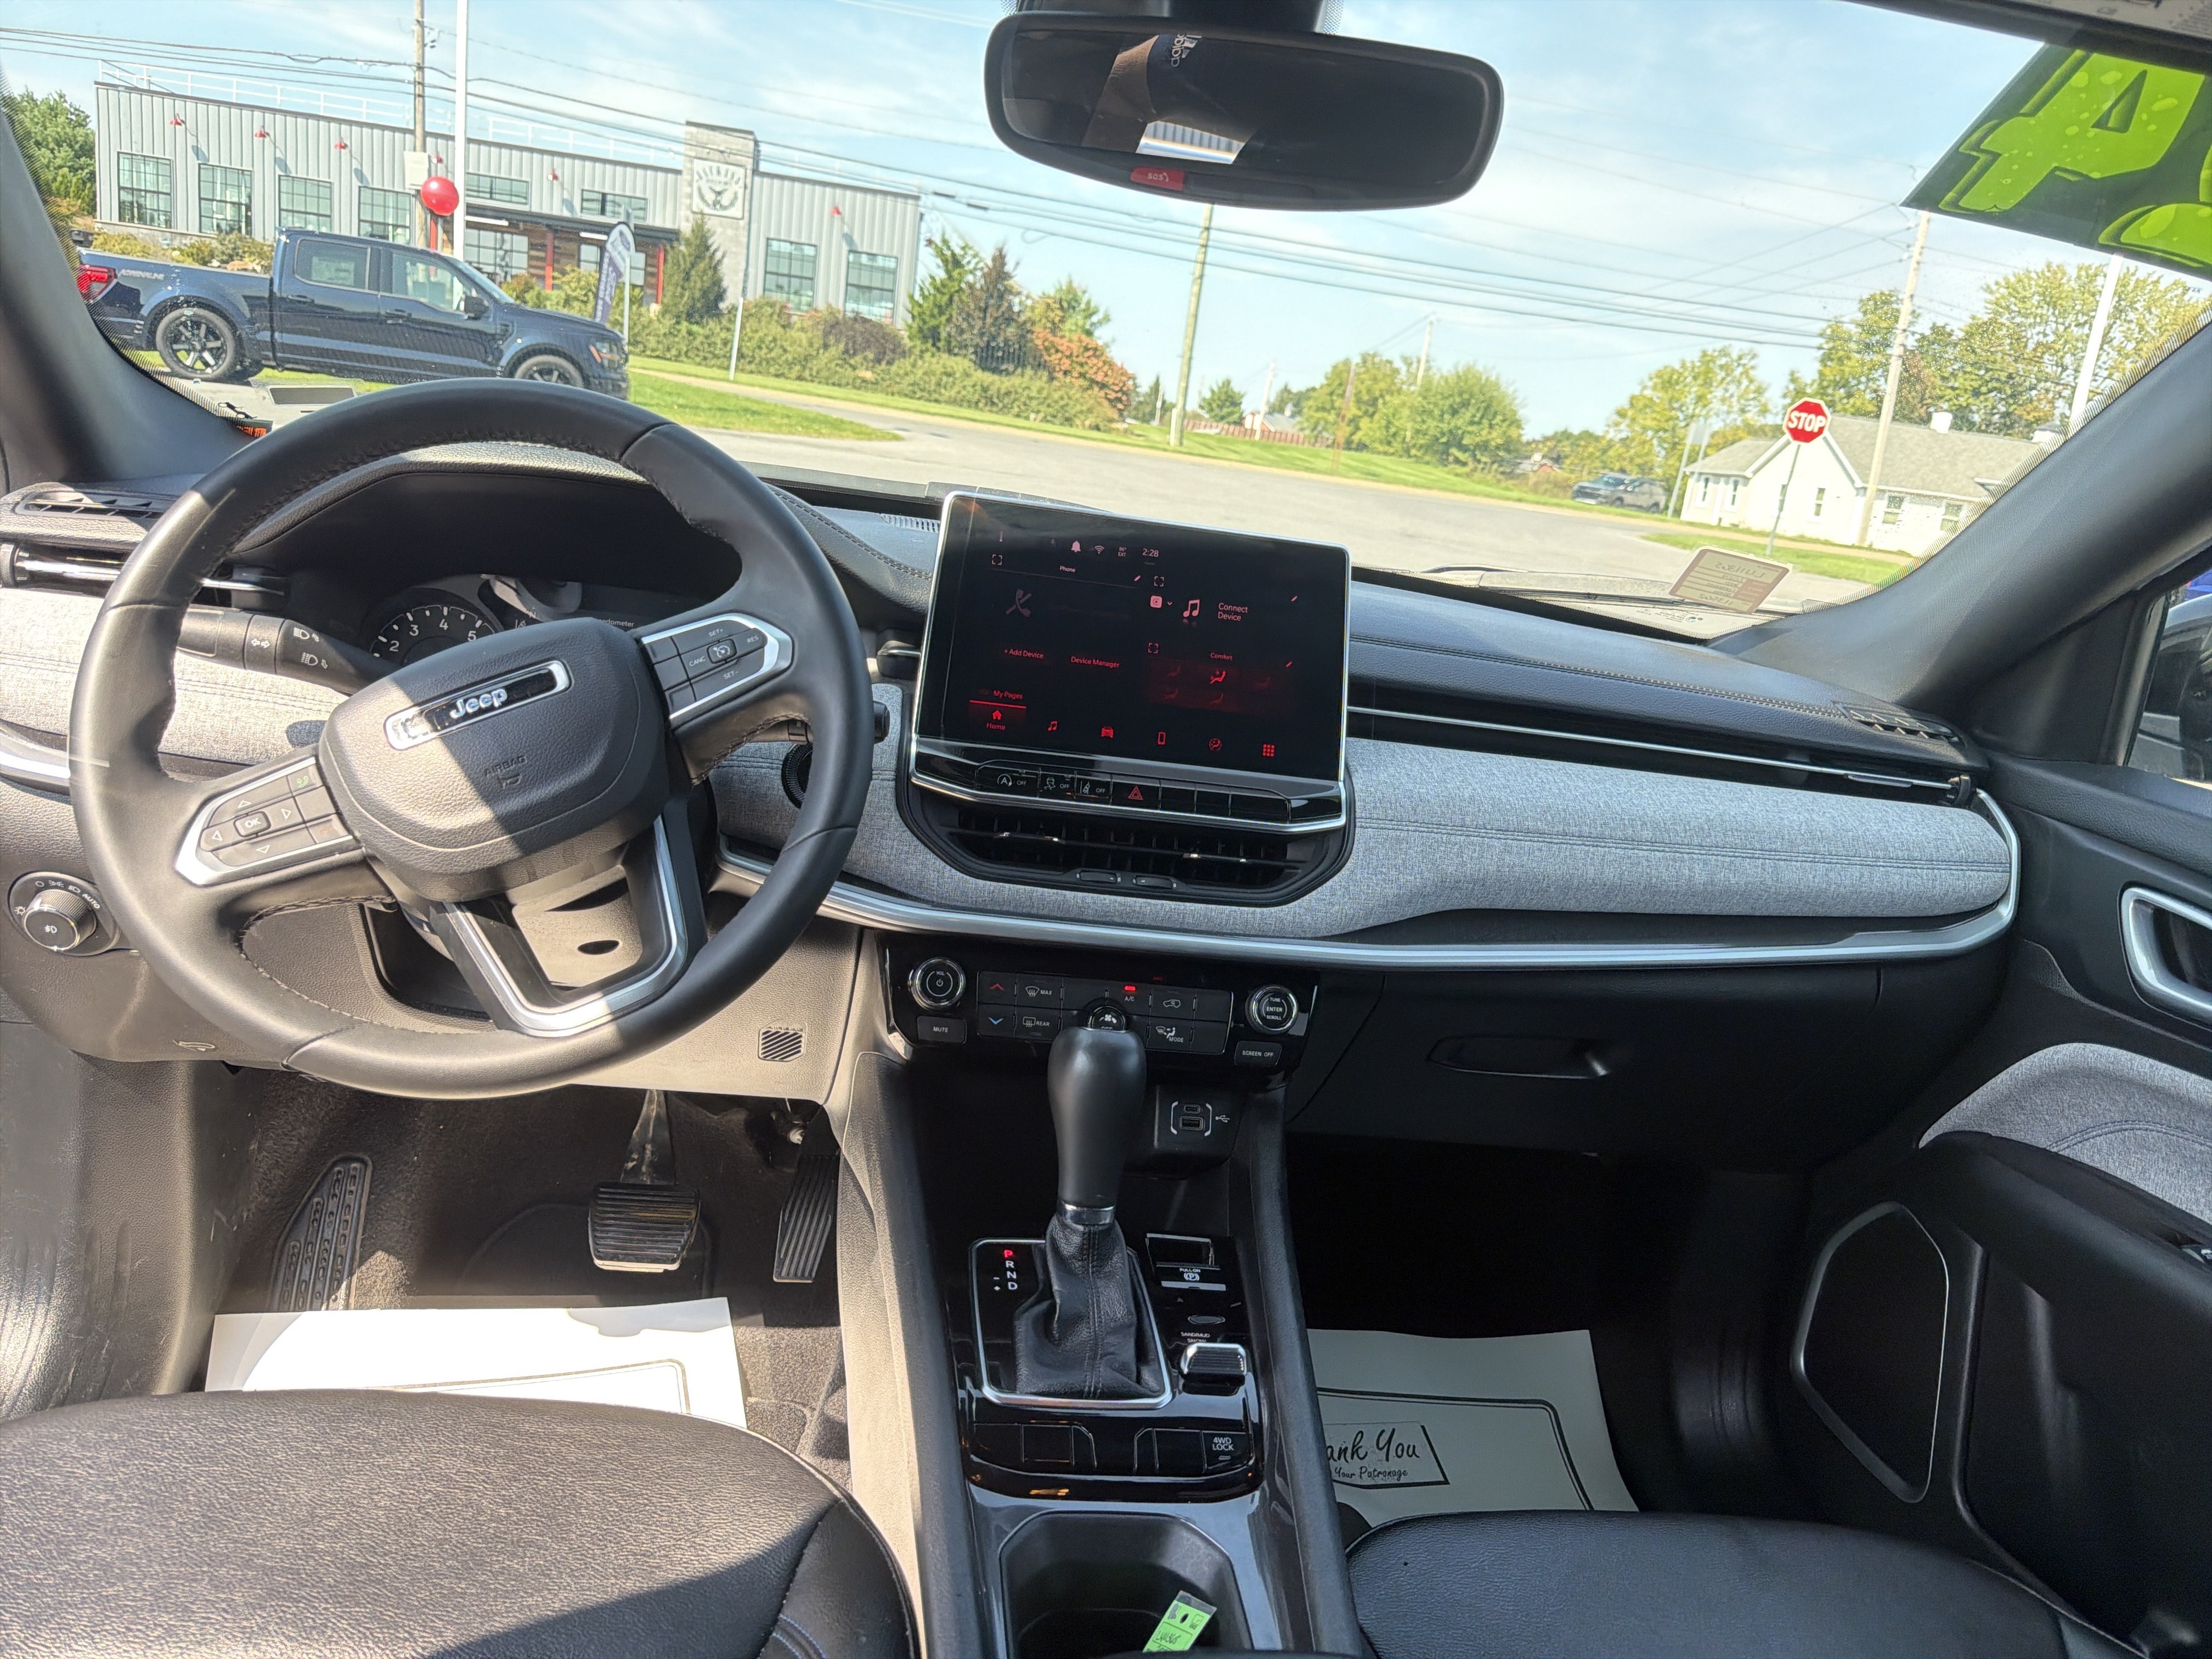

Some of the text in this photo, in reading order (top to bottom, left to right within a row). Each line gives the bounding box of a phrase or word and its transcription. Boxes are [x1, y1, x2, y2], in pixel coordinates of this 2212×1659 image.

[1787, 410, 1826, 433] STOP
[1142, 548, 1159, 557] 2:28
[1218, 602, 1249, 614] Connect
[1217, 612, 1242, 621] Device
[409, 624, 419, 636] 3
[439, 618, 449, 631] 4
[467, 630, 477, 642] 5
[747, 635, 759, 644] RES
[389, 640, 399, 652] 2
[1023, 650, 1044, 659] Device
[689, 656, 706, 667] CANC
[1070, 656, 1120, 669] Device Manager
[993, 690, 1023, 700] My Pages
[449, 688, 507, 719] Jeep
[245, 817, 262, 828] OK
[82, 894, 100, 909] AUTO
[1004, 1249, 1013, 1258] P
[1007, 1271, 1017, 1279] N
[1008, 1282, 1018, 1290] D
[1212, 1443, 1234, 1451] LOCK
[1326, 1427, 1420, 1463] ank You
[1334, 1465, 1408, 1481] Your Patronage
